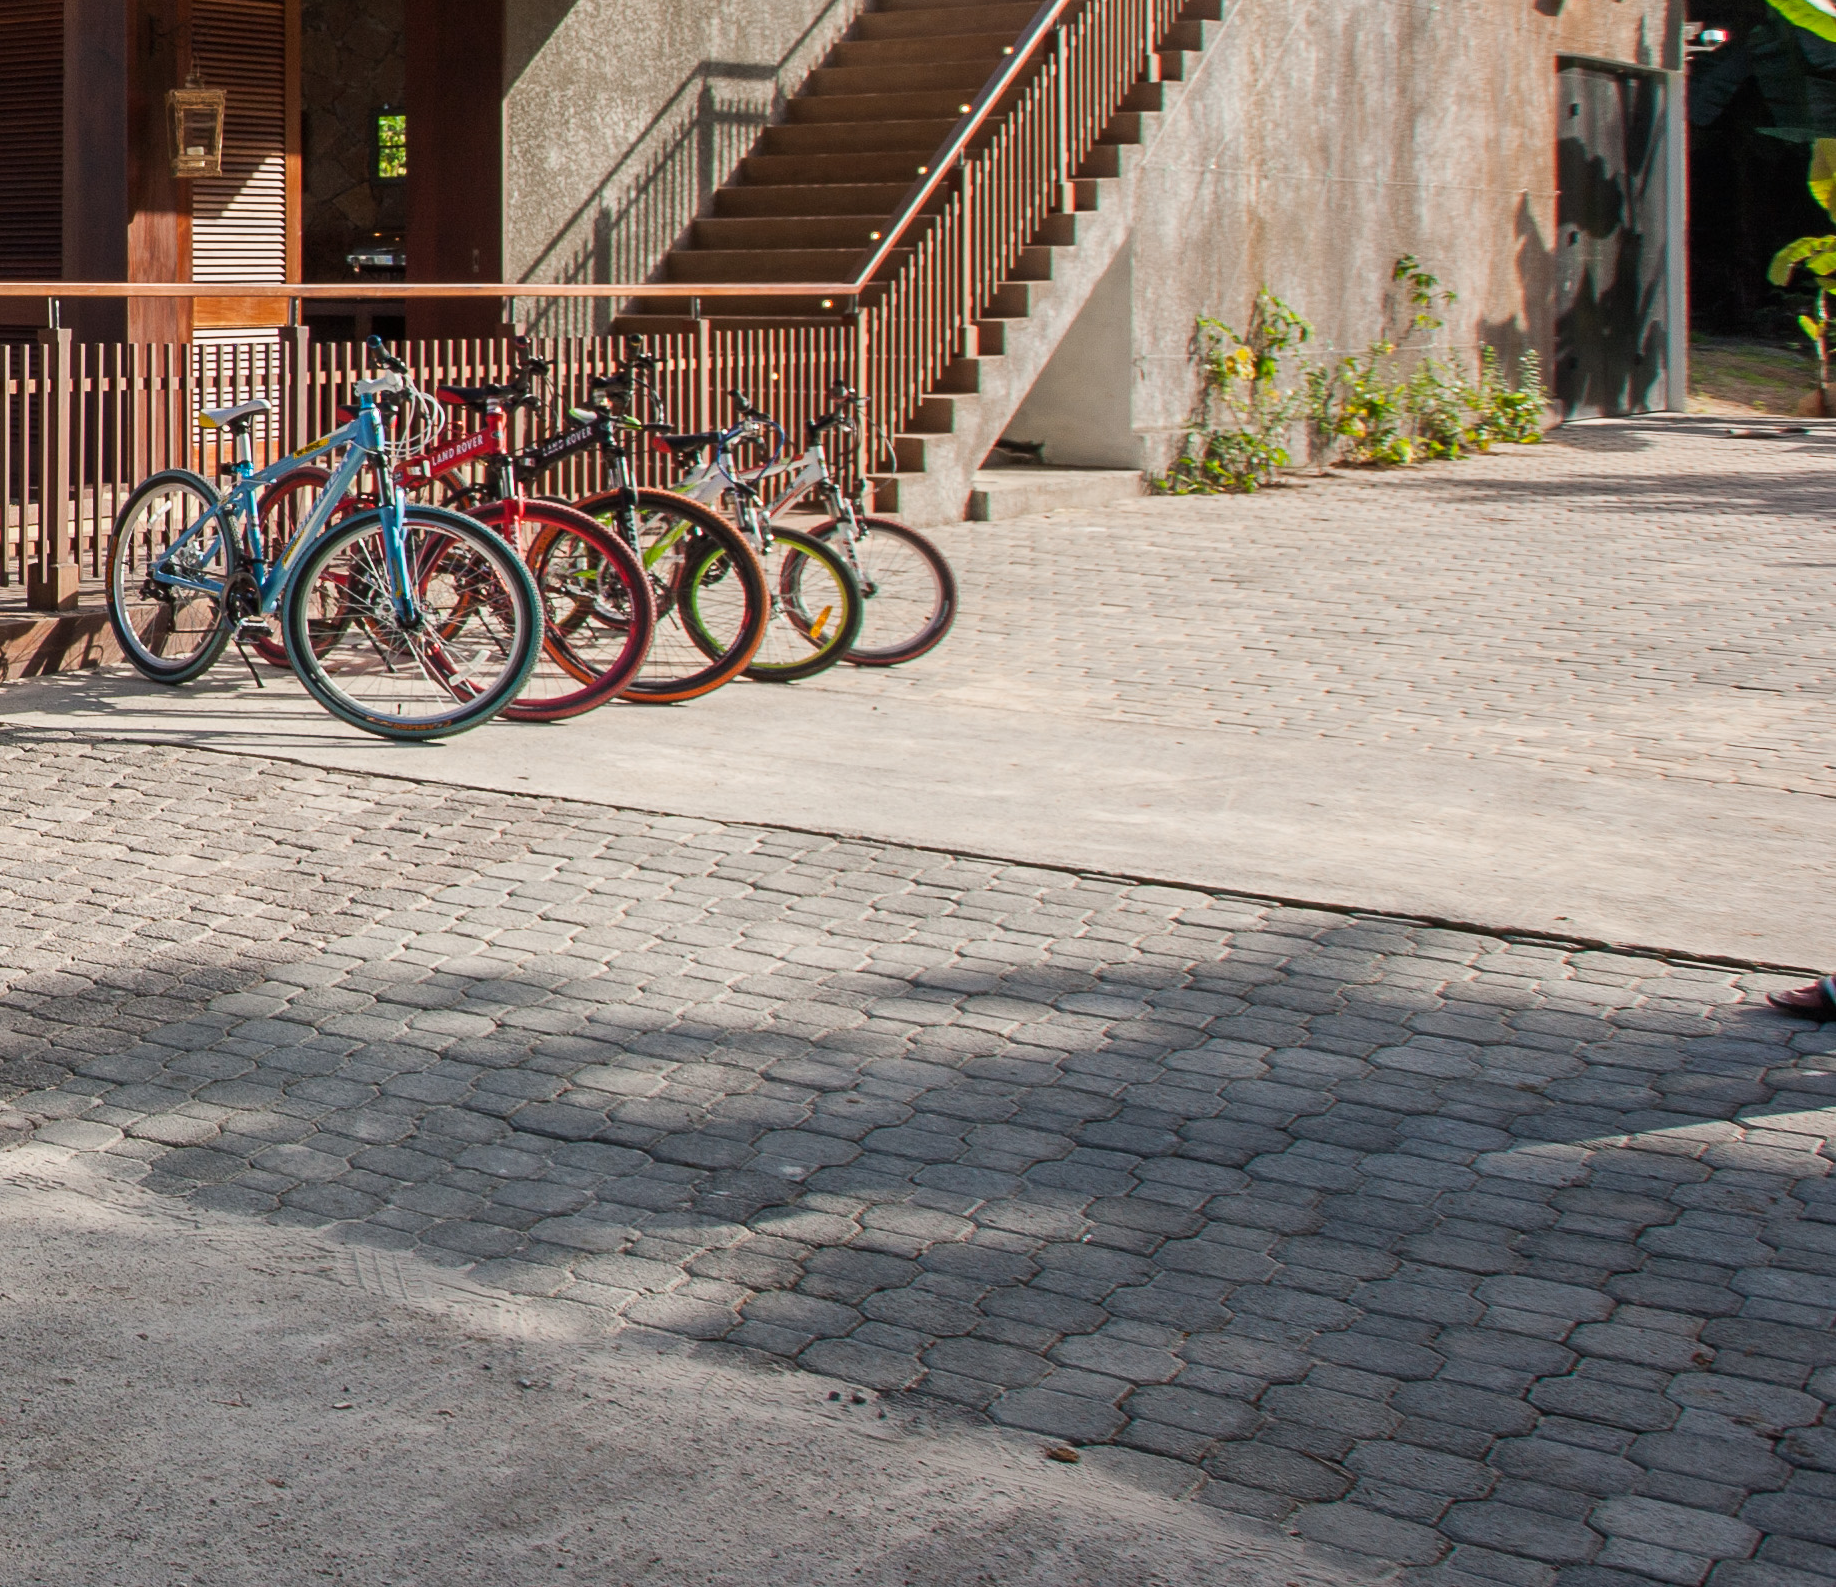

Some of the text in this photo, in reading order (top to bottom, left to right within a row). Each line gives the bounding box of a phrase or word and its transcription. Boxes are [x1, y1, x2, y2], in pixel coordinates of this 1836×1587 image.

[565, 426, 594, 447] ROVER
[431, 434, 485, 466] LAND ROVER
